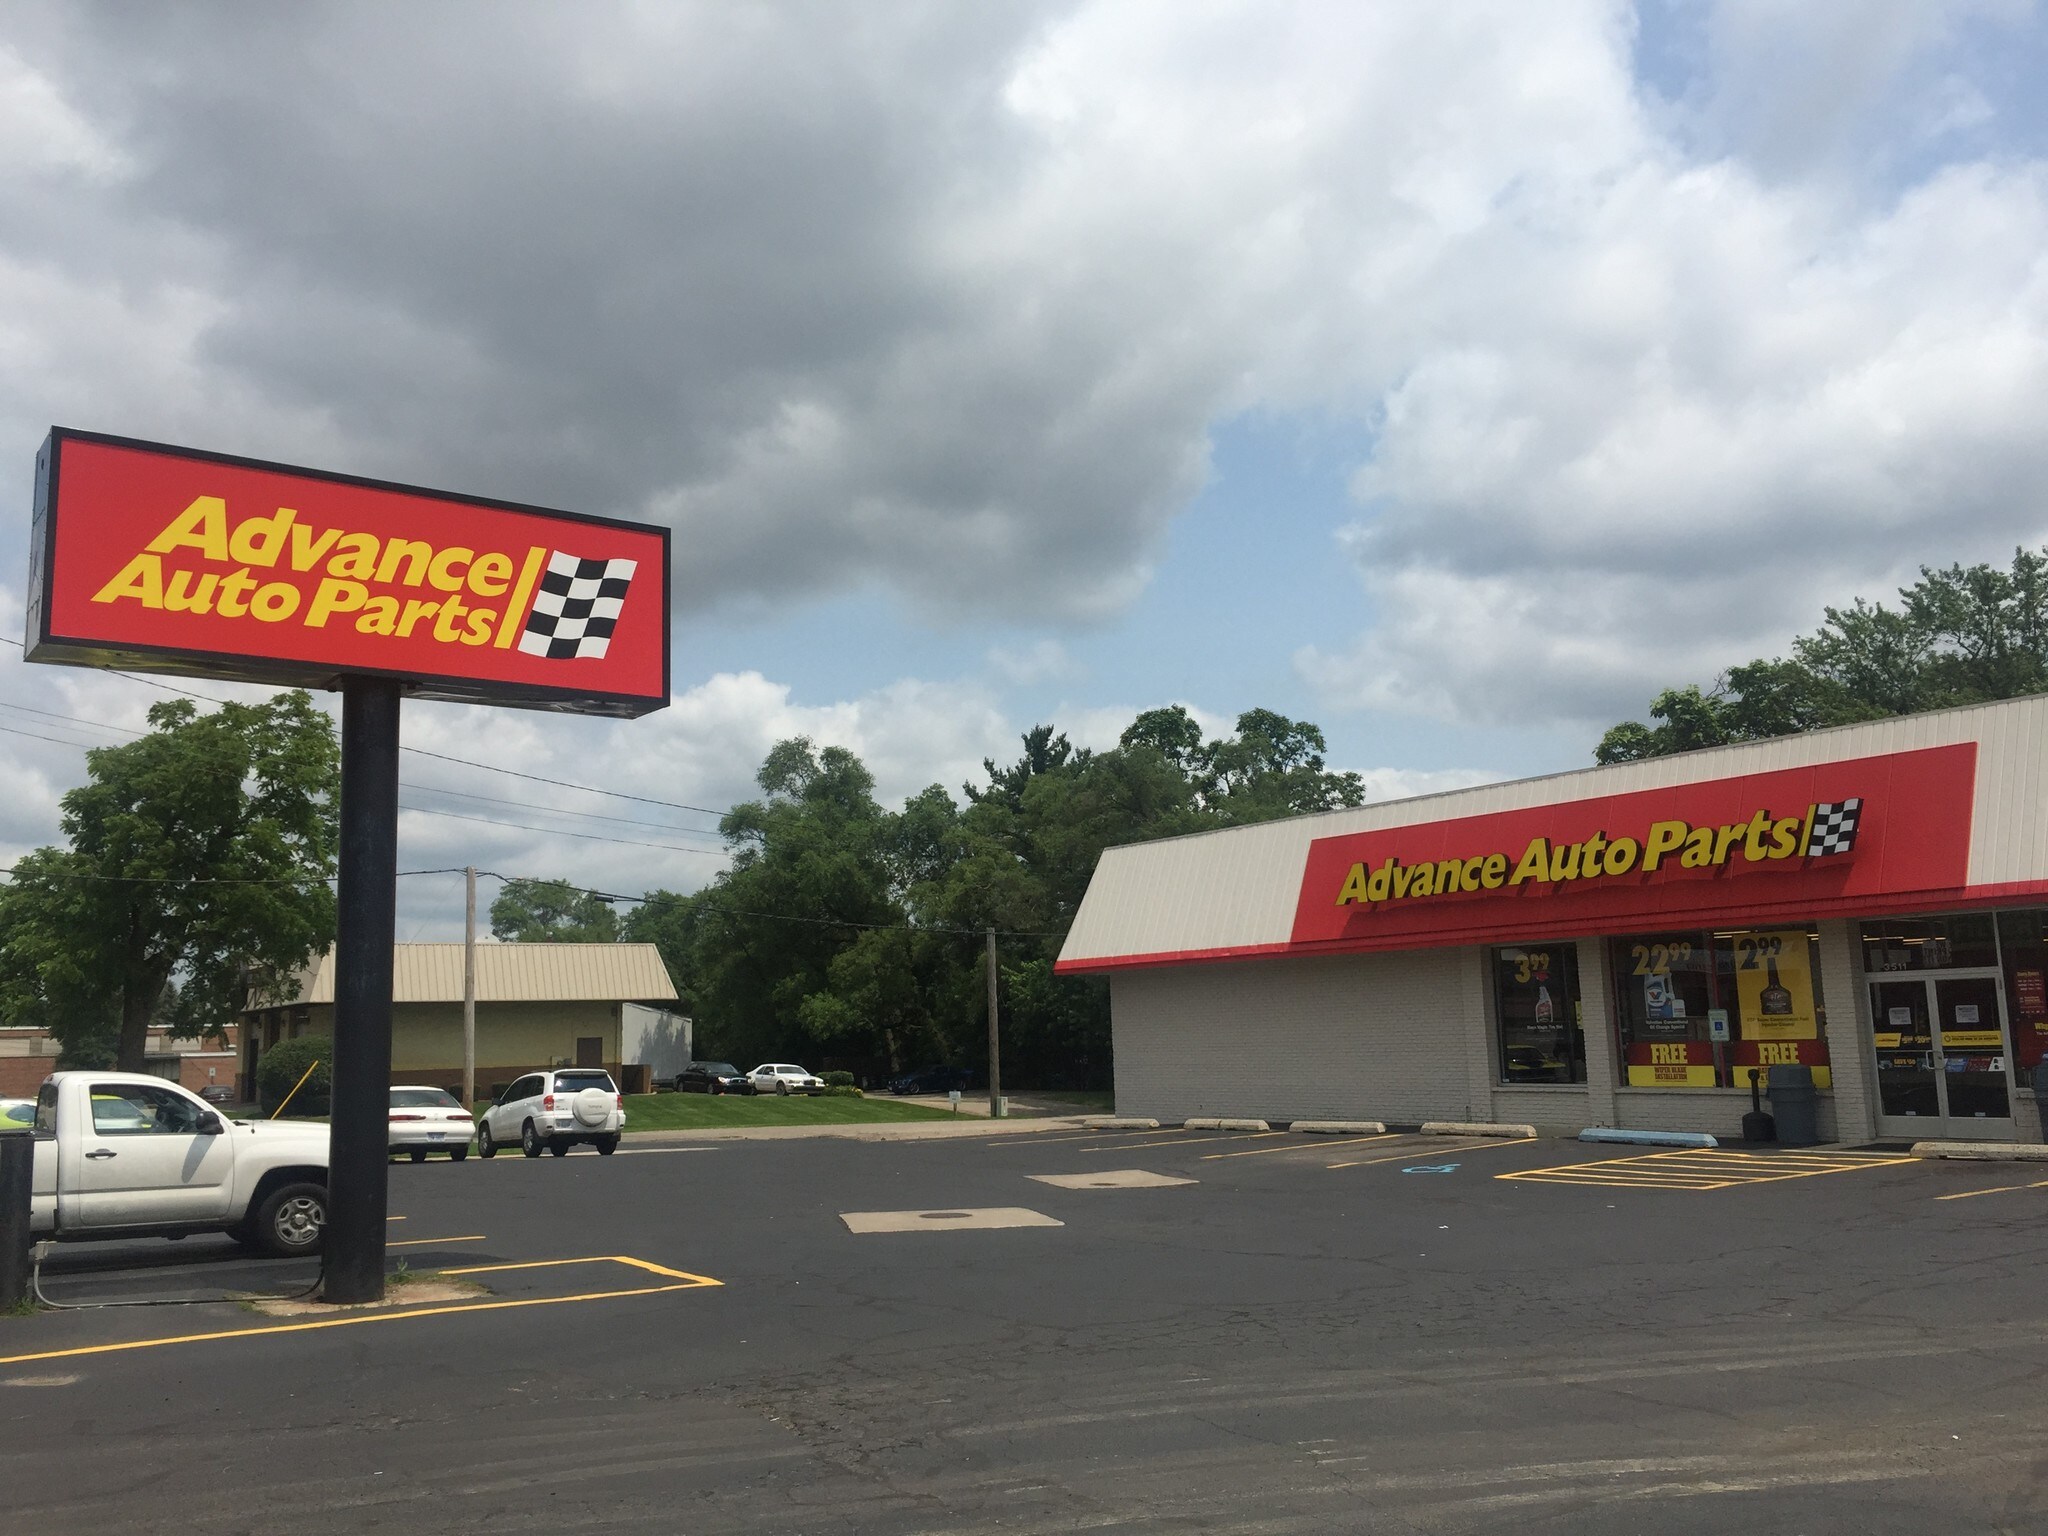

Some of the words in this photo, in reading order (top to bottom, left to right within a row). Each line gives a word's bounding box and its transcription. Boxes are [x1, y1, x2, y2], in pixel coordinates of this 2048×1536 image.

[144, 495, 514, 597] Advance
[90, 553, 301, 622] Auto
[303, 577, 498, 646] Parts
[1337, 852, 1508, 905] Advance
[1508, 831, 1639, 886] Auto
[1641, 809, 1800, 872] Parts
[1883, 962, 1907, 971] 3511
[1650, 1043, 1688, 1065] FREE
[1758, 1042, 1800, 1065] FREE
